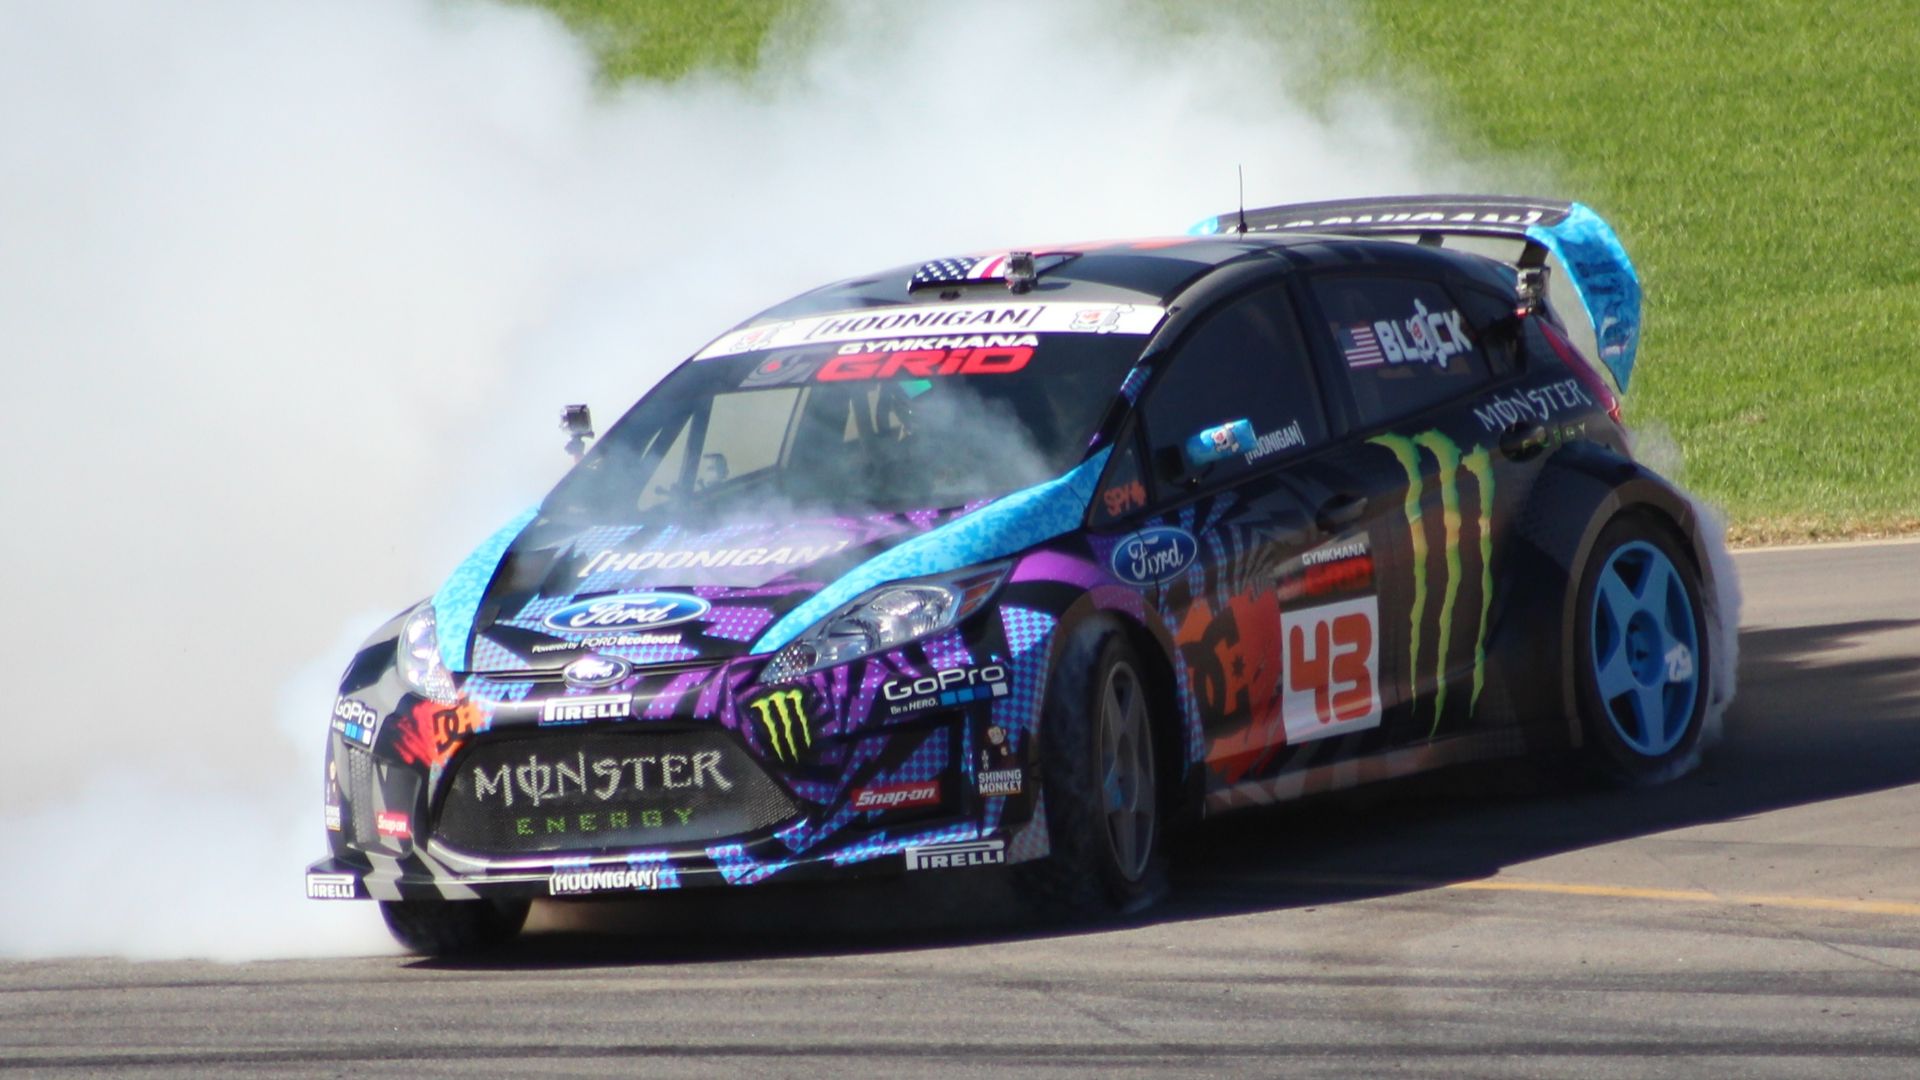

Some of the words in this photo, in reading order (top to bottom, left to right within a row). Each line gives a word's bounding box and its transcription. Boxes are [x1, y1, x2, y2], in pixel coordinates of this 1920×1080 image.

[838, 334, 1039, 355] GYMKHANA
[1473, 379, 1592, 433] MONSTER
[1128, 536, 1184, 580] Ford
[1302, 543, 1367, 566] GYMKHANA
[569, 597, 680, 628] Ford
[580, 637, 617, 648] FORD
[1289, 612, 1373, 725] 43
[883, 666, 1004, 701] GoPro
[335, 695, 376, 729] GoPro
[543, 693, 632, 722] PIRELLI
[474, 751, 733, 807] MONSTER
[978, 768, 1022, 784] SHINING
[979, 780, 1022, 795] MONKEY
[856, 787, 936, 806] Snap-on
[516, 807, 696, 836] ENERGY
[905, 840, 1004, 871] PIRELLI
[307, 873, 355, 899] PIRELLI
